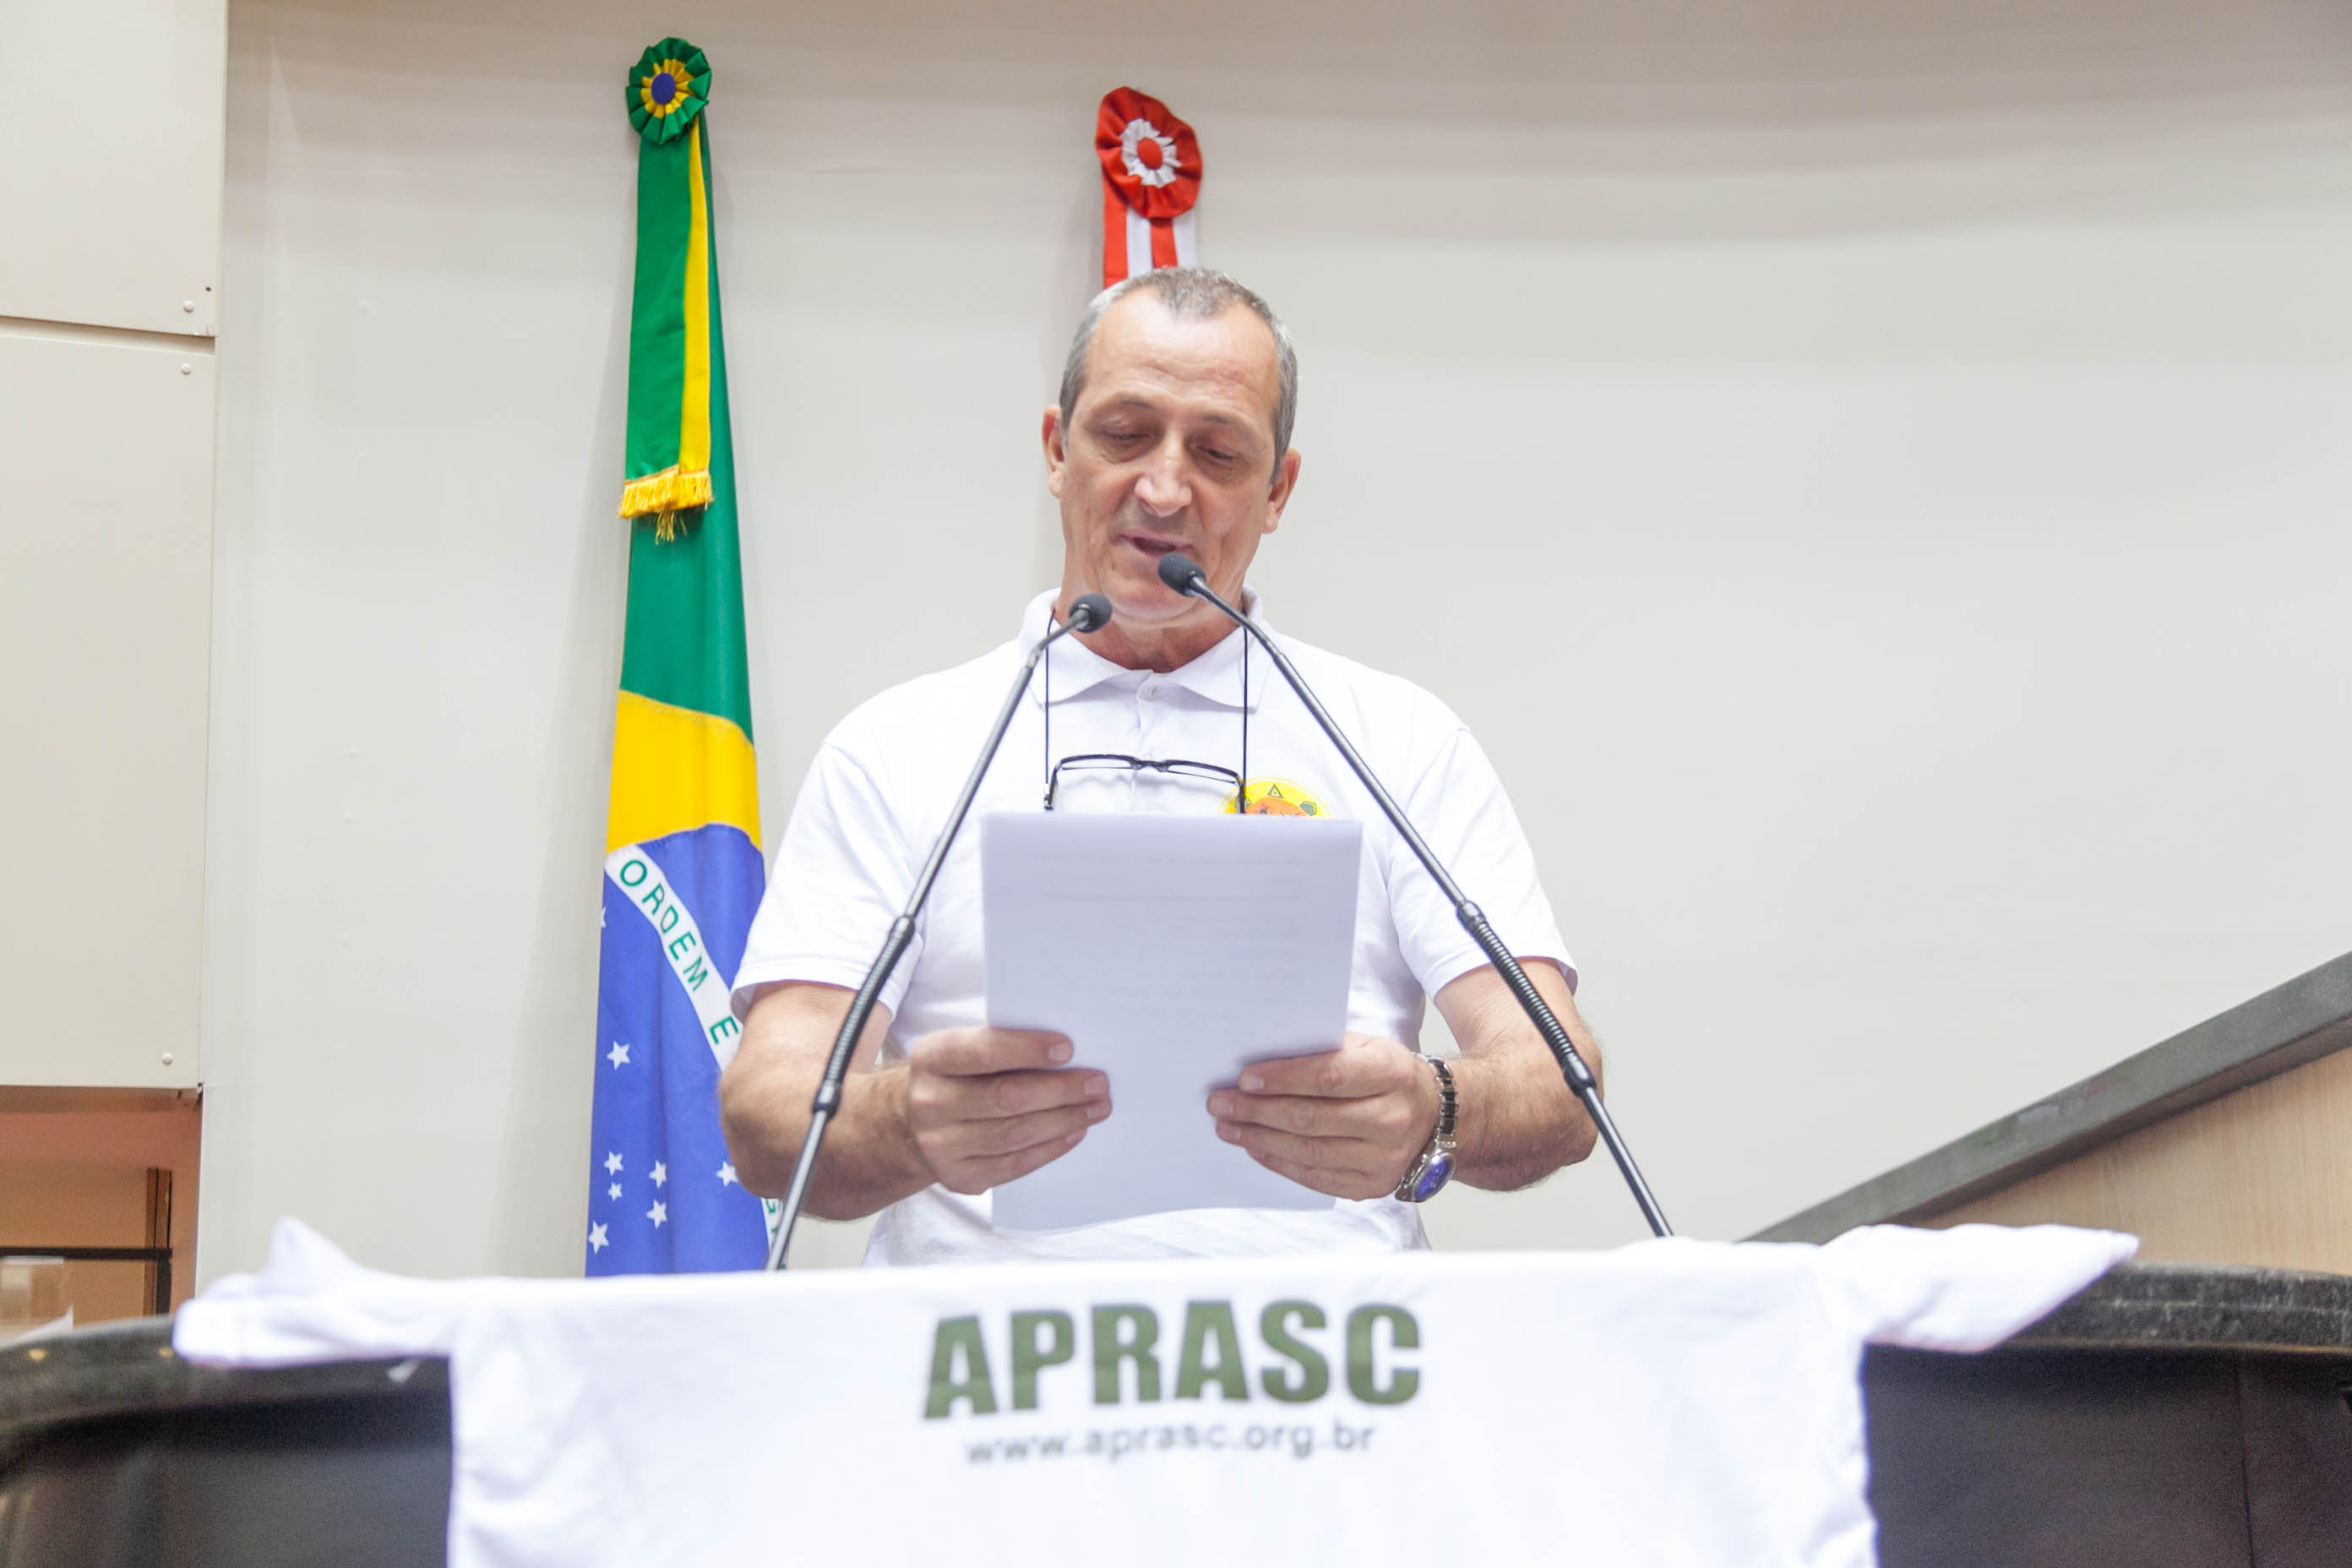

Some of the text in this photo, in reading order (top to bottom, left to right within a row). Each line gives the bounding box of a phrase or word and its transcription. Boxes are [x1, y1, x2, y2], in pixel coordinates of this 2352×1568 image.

[619, 859, 739, 1046] ORDEM E
[923, 1299, 1421, 1421] APRASC
[966, 1419, 1376, 1462] www.aprasc.org.br
